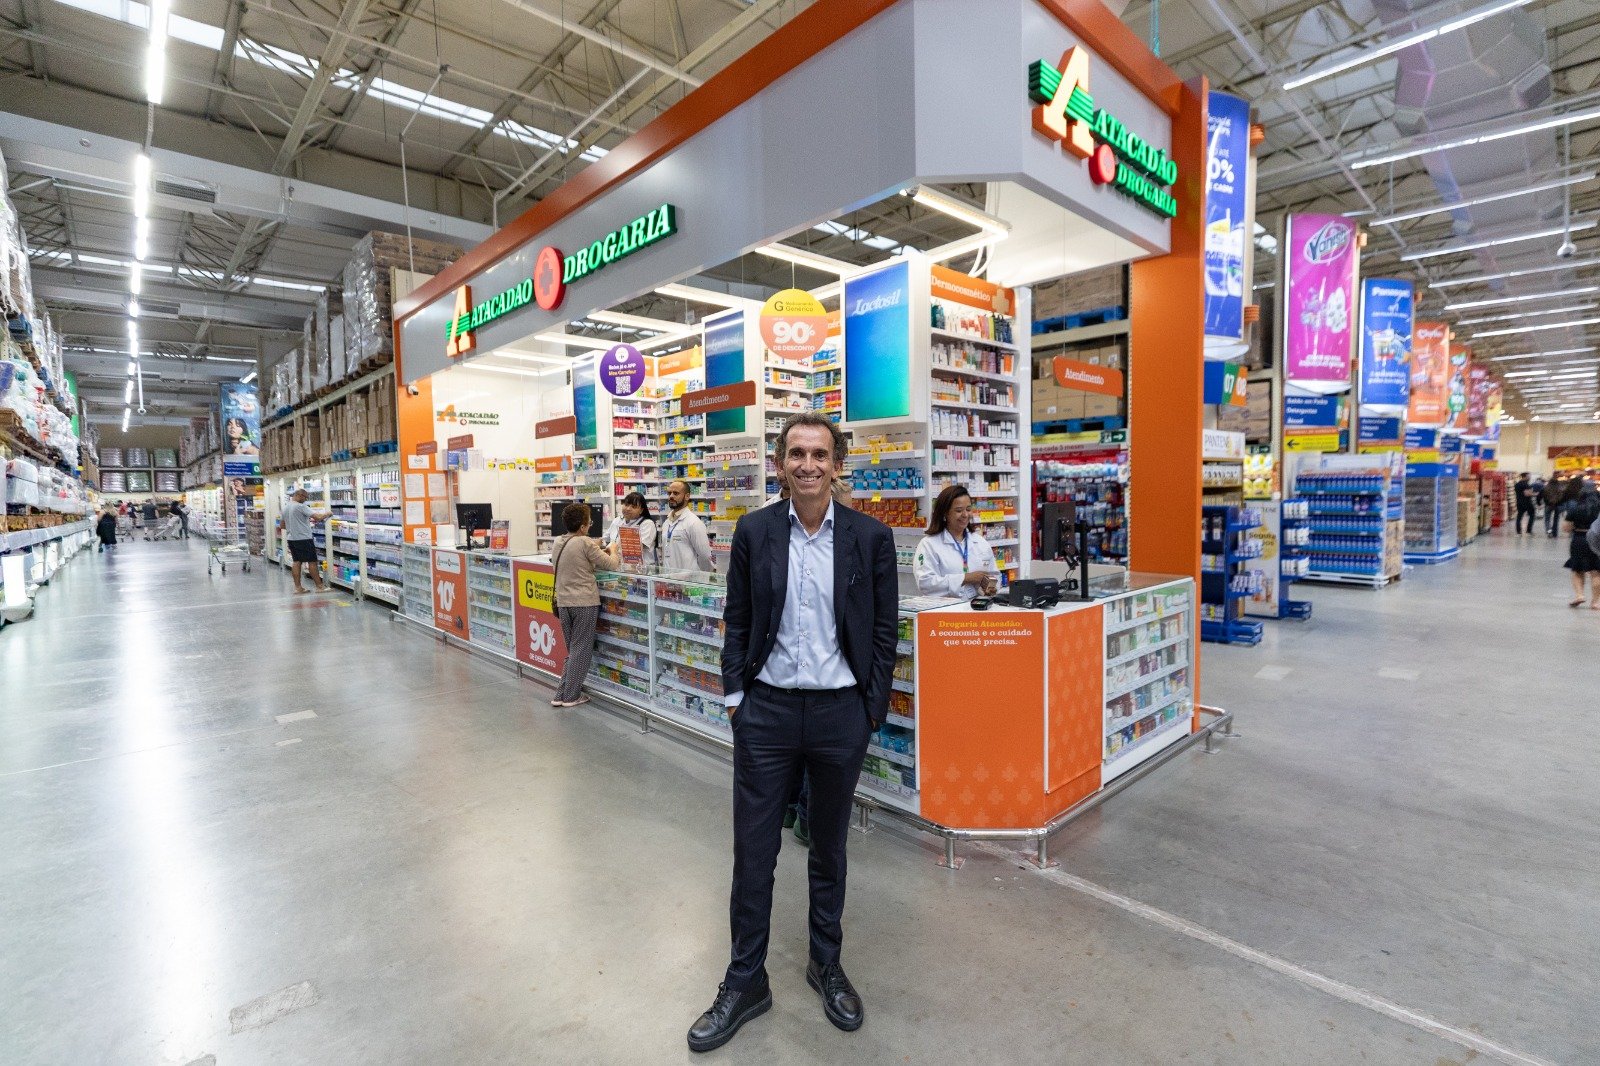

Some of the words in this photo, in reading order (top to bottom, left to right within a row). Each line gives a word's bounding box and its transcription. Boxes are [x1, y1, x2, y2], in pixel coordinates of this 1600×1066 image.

[1117, 163, 1177, 217] DROGARIA
[563, 204, 674, 284] DROGARIA
[931, 275, 991, 302] Dermocosmético
[775, 301, 783, 311] G
[773, 321, 815, 344] 90%
[1065, 367, 1104, 385] Atendimento
[1224, 373, 1234, 393] 07
[1236, 377, 1246, 396] 08
[689, 394, 729, 408] Atendimento
[525, 579, 533, 599] G
[938, 620, 978, 629] Drogaria
[980, 620, 1023, 628] Atacadão:
[529, 620, 556, 655] 90%
[983, 638, 1018, 647] precisa.
